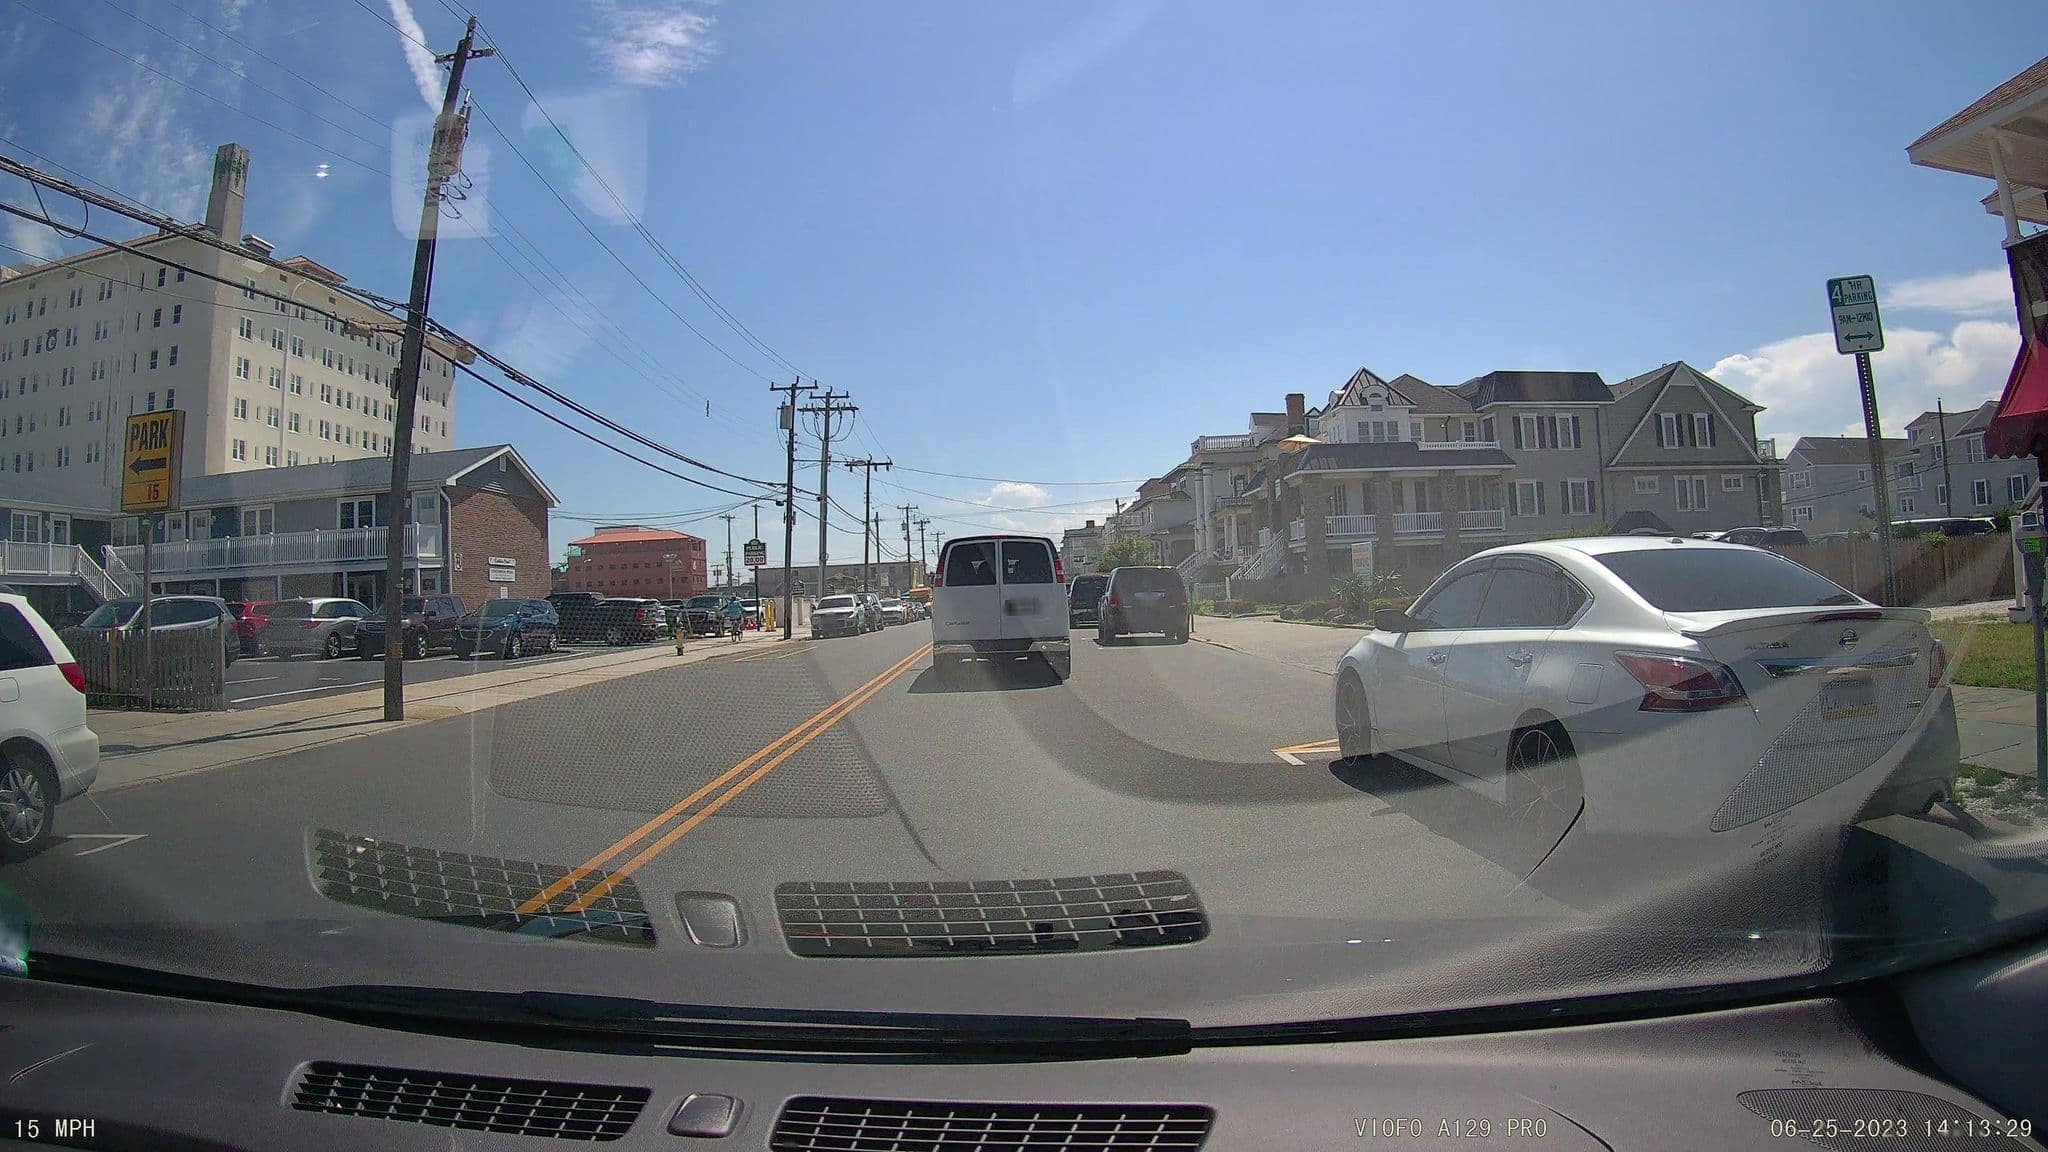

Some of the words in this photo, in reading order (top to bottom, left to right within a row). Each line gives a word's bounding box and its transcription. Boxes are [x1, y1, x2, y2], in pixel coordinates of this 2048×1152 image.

[1832, 285, 1842, 302] 4
[1850, 280, 1862, 290] HR
[1844, 291, 1873, 303] PARKING
[129, 419, 169, 452] PARK
[147, 483, 160, 501] 15
